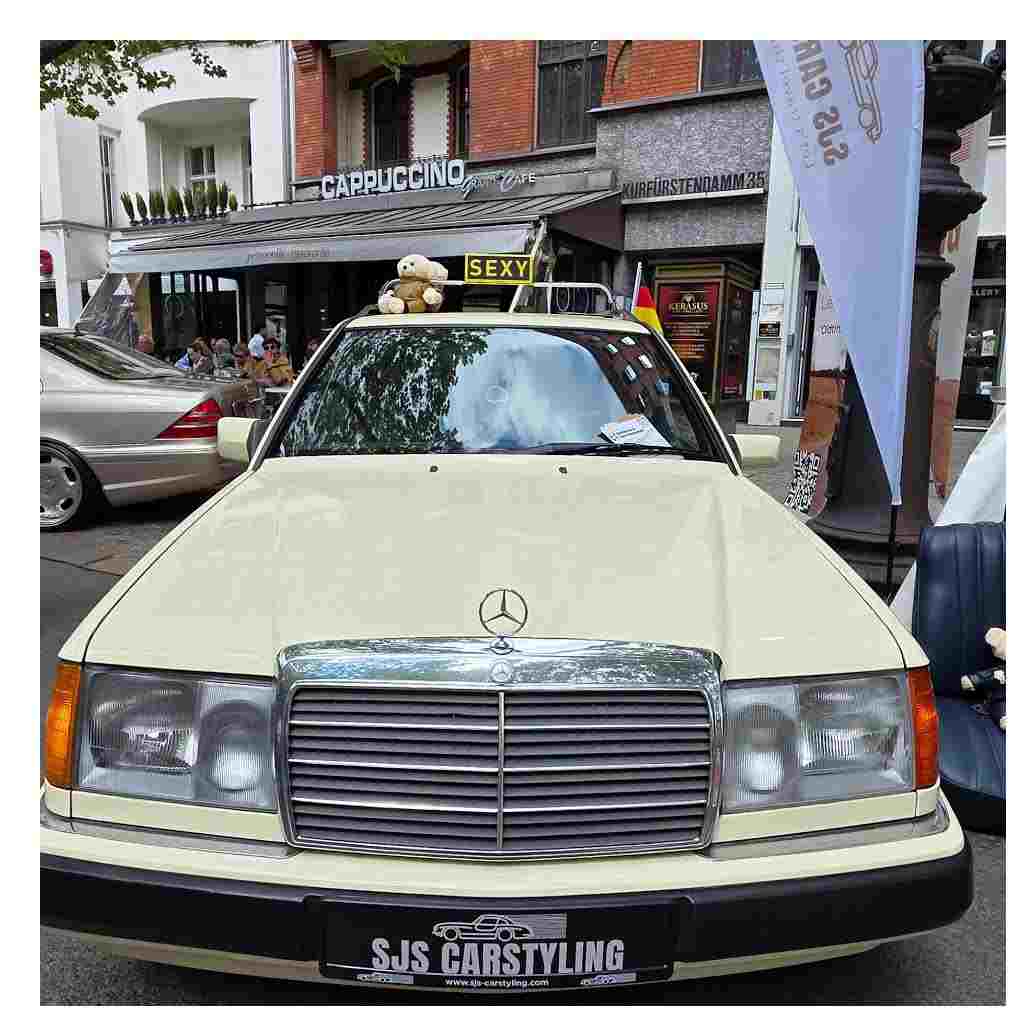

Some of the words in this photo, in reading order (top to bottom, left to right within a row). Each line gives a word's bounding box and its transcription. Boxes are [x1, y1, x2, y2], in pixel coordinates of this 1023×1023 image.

[321, 159, 465, 200] CAPPUCCINO
[622, 172, 745, 199] KURFÜRSTENDAMM
[470, 258, 529, 278] SEXY
[371, 937, 431, 973] SJS
[440, 939, 625, 977] CARSTYLING
